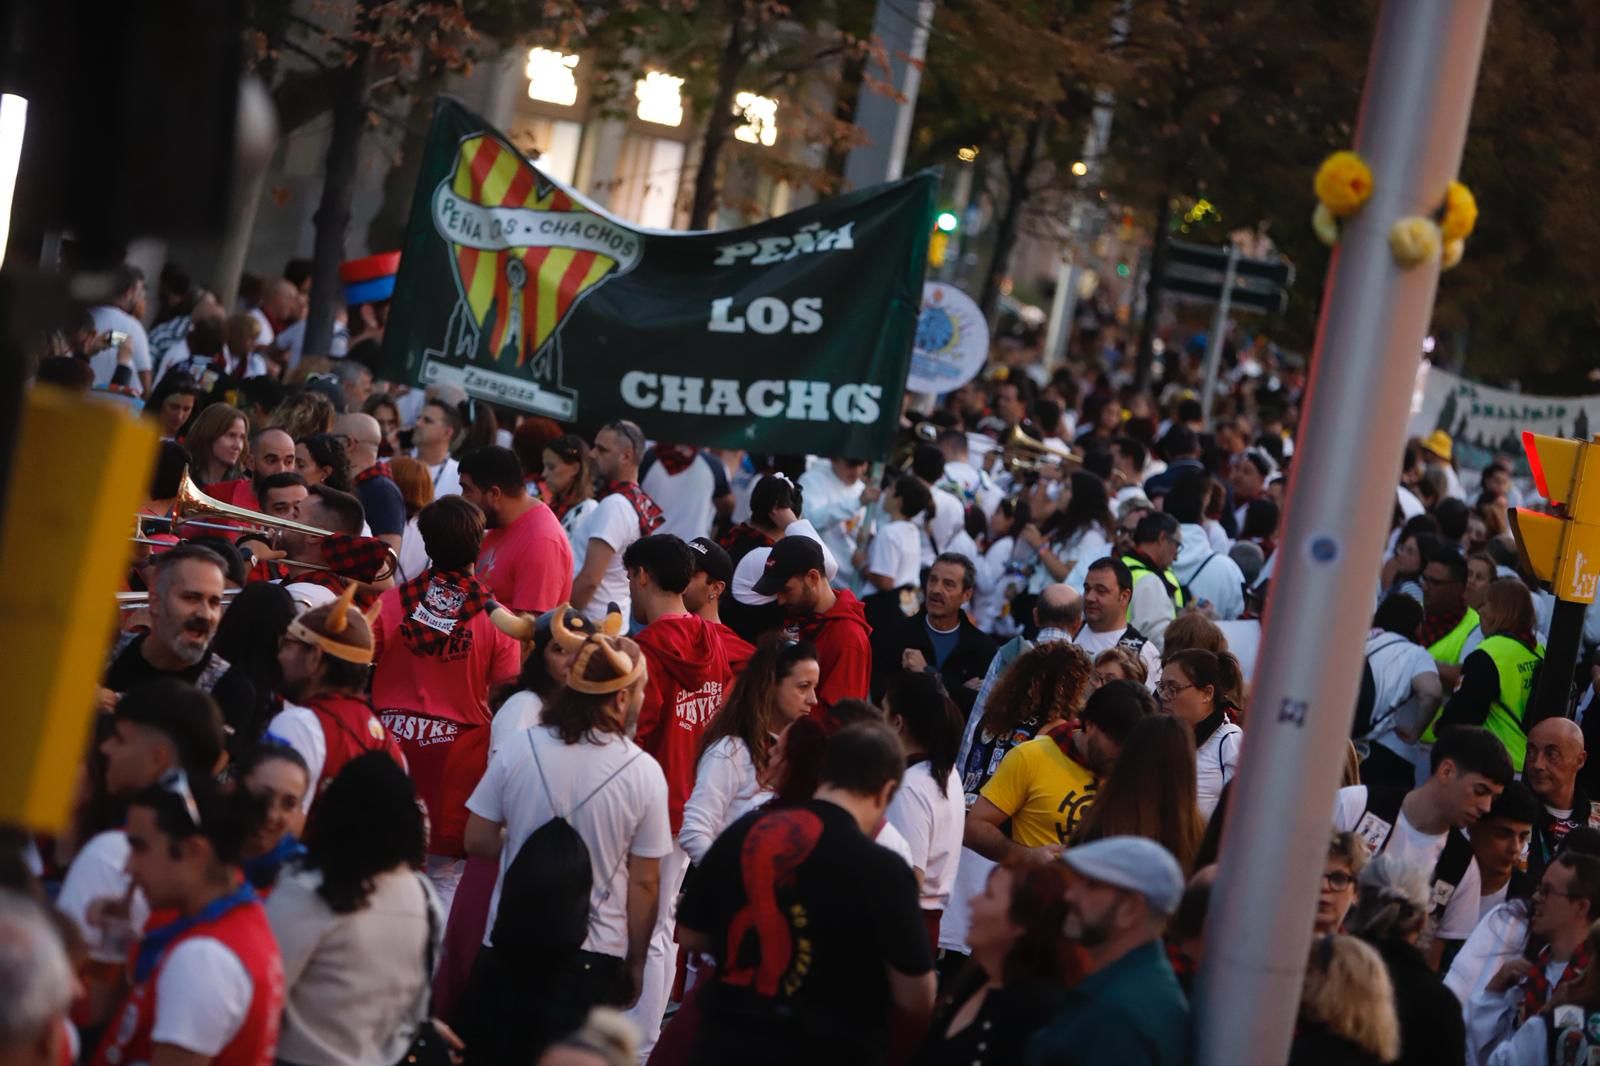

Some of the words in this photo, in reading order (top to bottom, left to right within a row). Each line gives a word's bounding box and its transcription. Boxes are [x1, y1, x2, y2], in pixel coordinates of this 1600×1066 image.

[441, 198, 482, 241] PEÑA
[539, 218, 635, 257] CHACHOS
[713, 222, 855, 265] PEÑA
[707, 297, 823, 334] LOS
[464, 369, 536, 400] Zaragoza
[620, 371, 882, 424] CHACHOS
[381, 714, 458, 740] WESYKE
